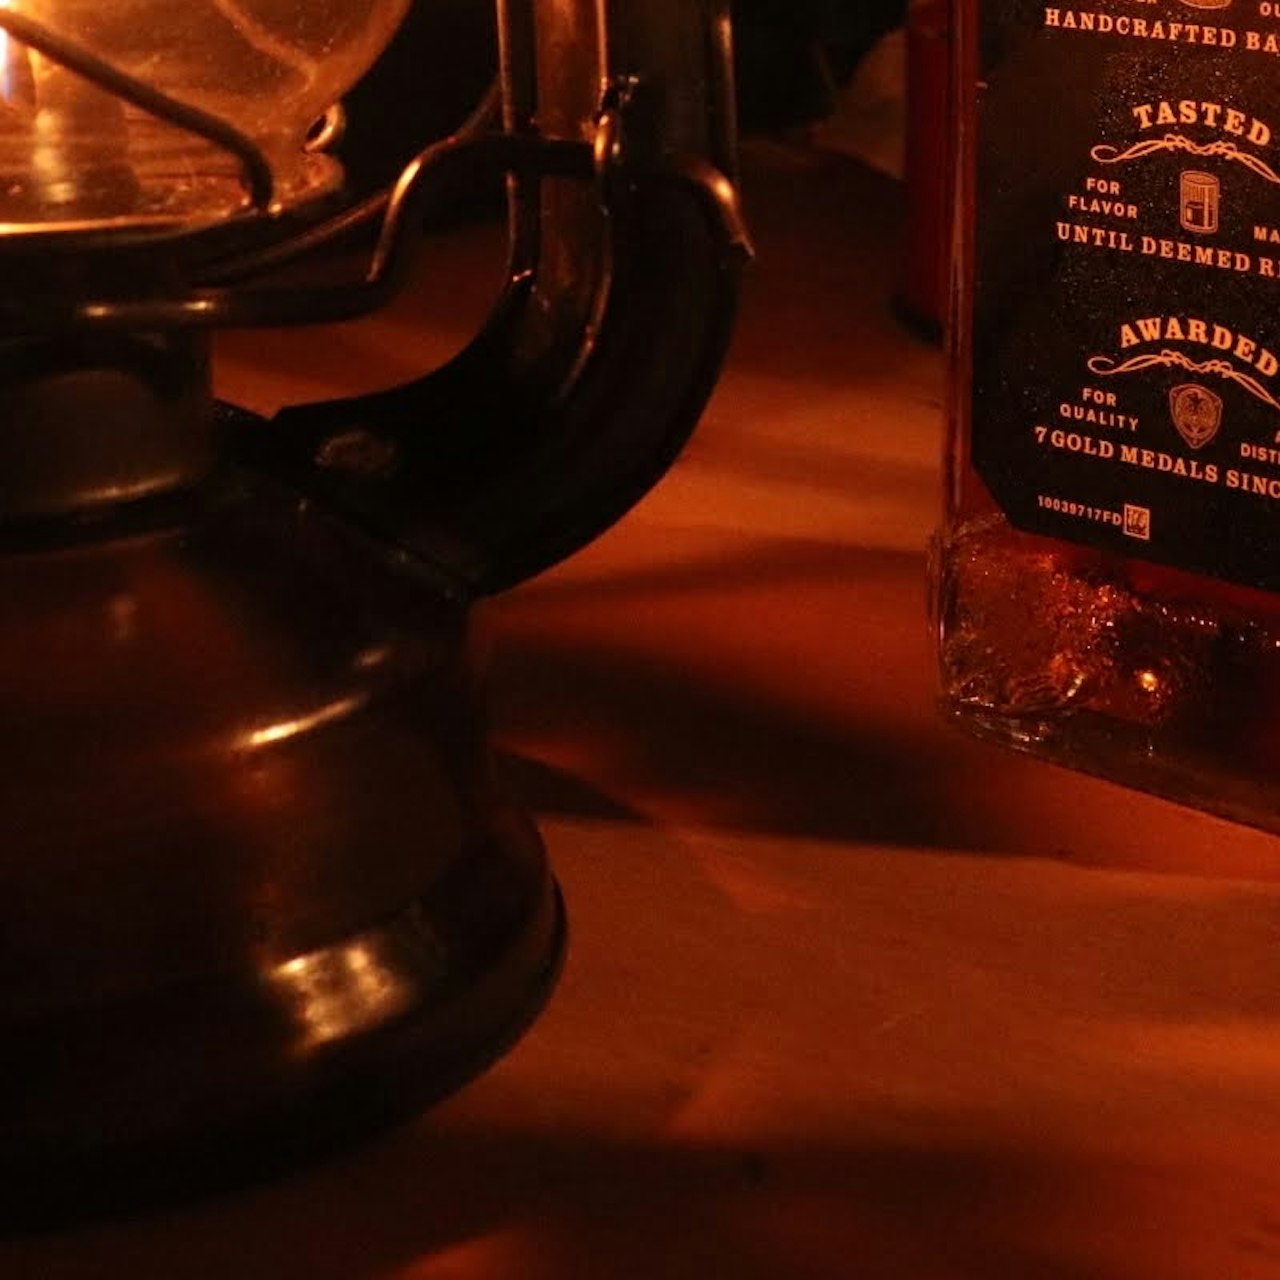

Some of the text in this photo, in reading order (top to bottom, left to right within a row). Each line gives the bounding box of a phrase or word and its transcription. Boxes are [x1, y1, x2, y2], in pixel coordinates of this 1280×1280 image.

[1044, 7, 1237, 48] HANDCRAFTED
[1132, 100, 1272, 147] TASTED
[1086, 177, 1121, 195] FOR
[1069, 196, 1138, 220] FLAVOR
[1056, 222, 1133, 252] UNTIL
[1142, 236, 1251, 273] DEEMED
[1120, 317, 1280, 378] AWARDED
[1082, 387, 1117, 406] FOR
[1060, 403, 1139, 432] QUALITY
[1035, 426, 1048, 446] 7
[1051, 429, 1114, 460] GOLD
[1121, 444, 1218, 484] MEDALS
[1037, 494, 1122, 527] 10039717FD
